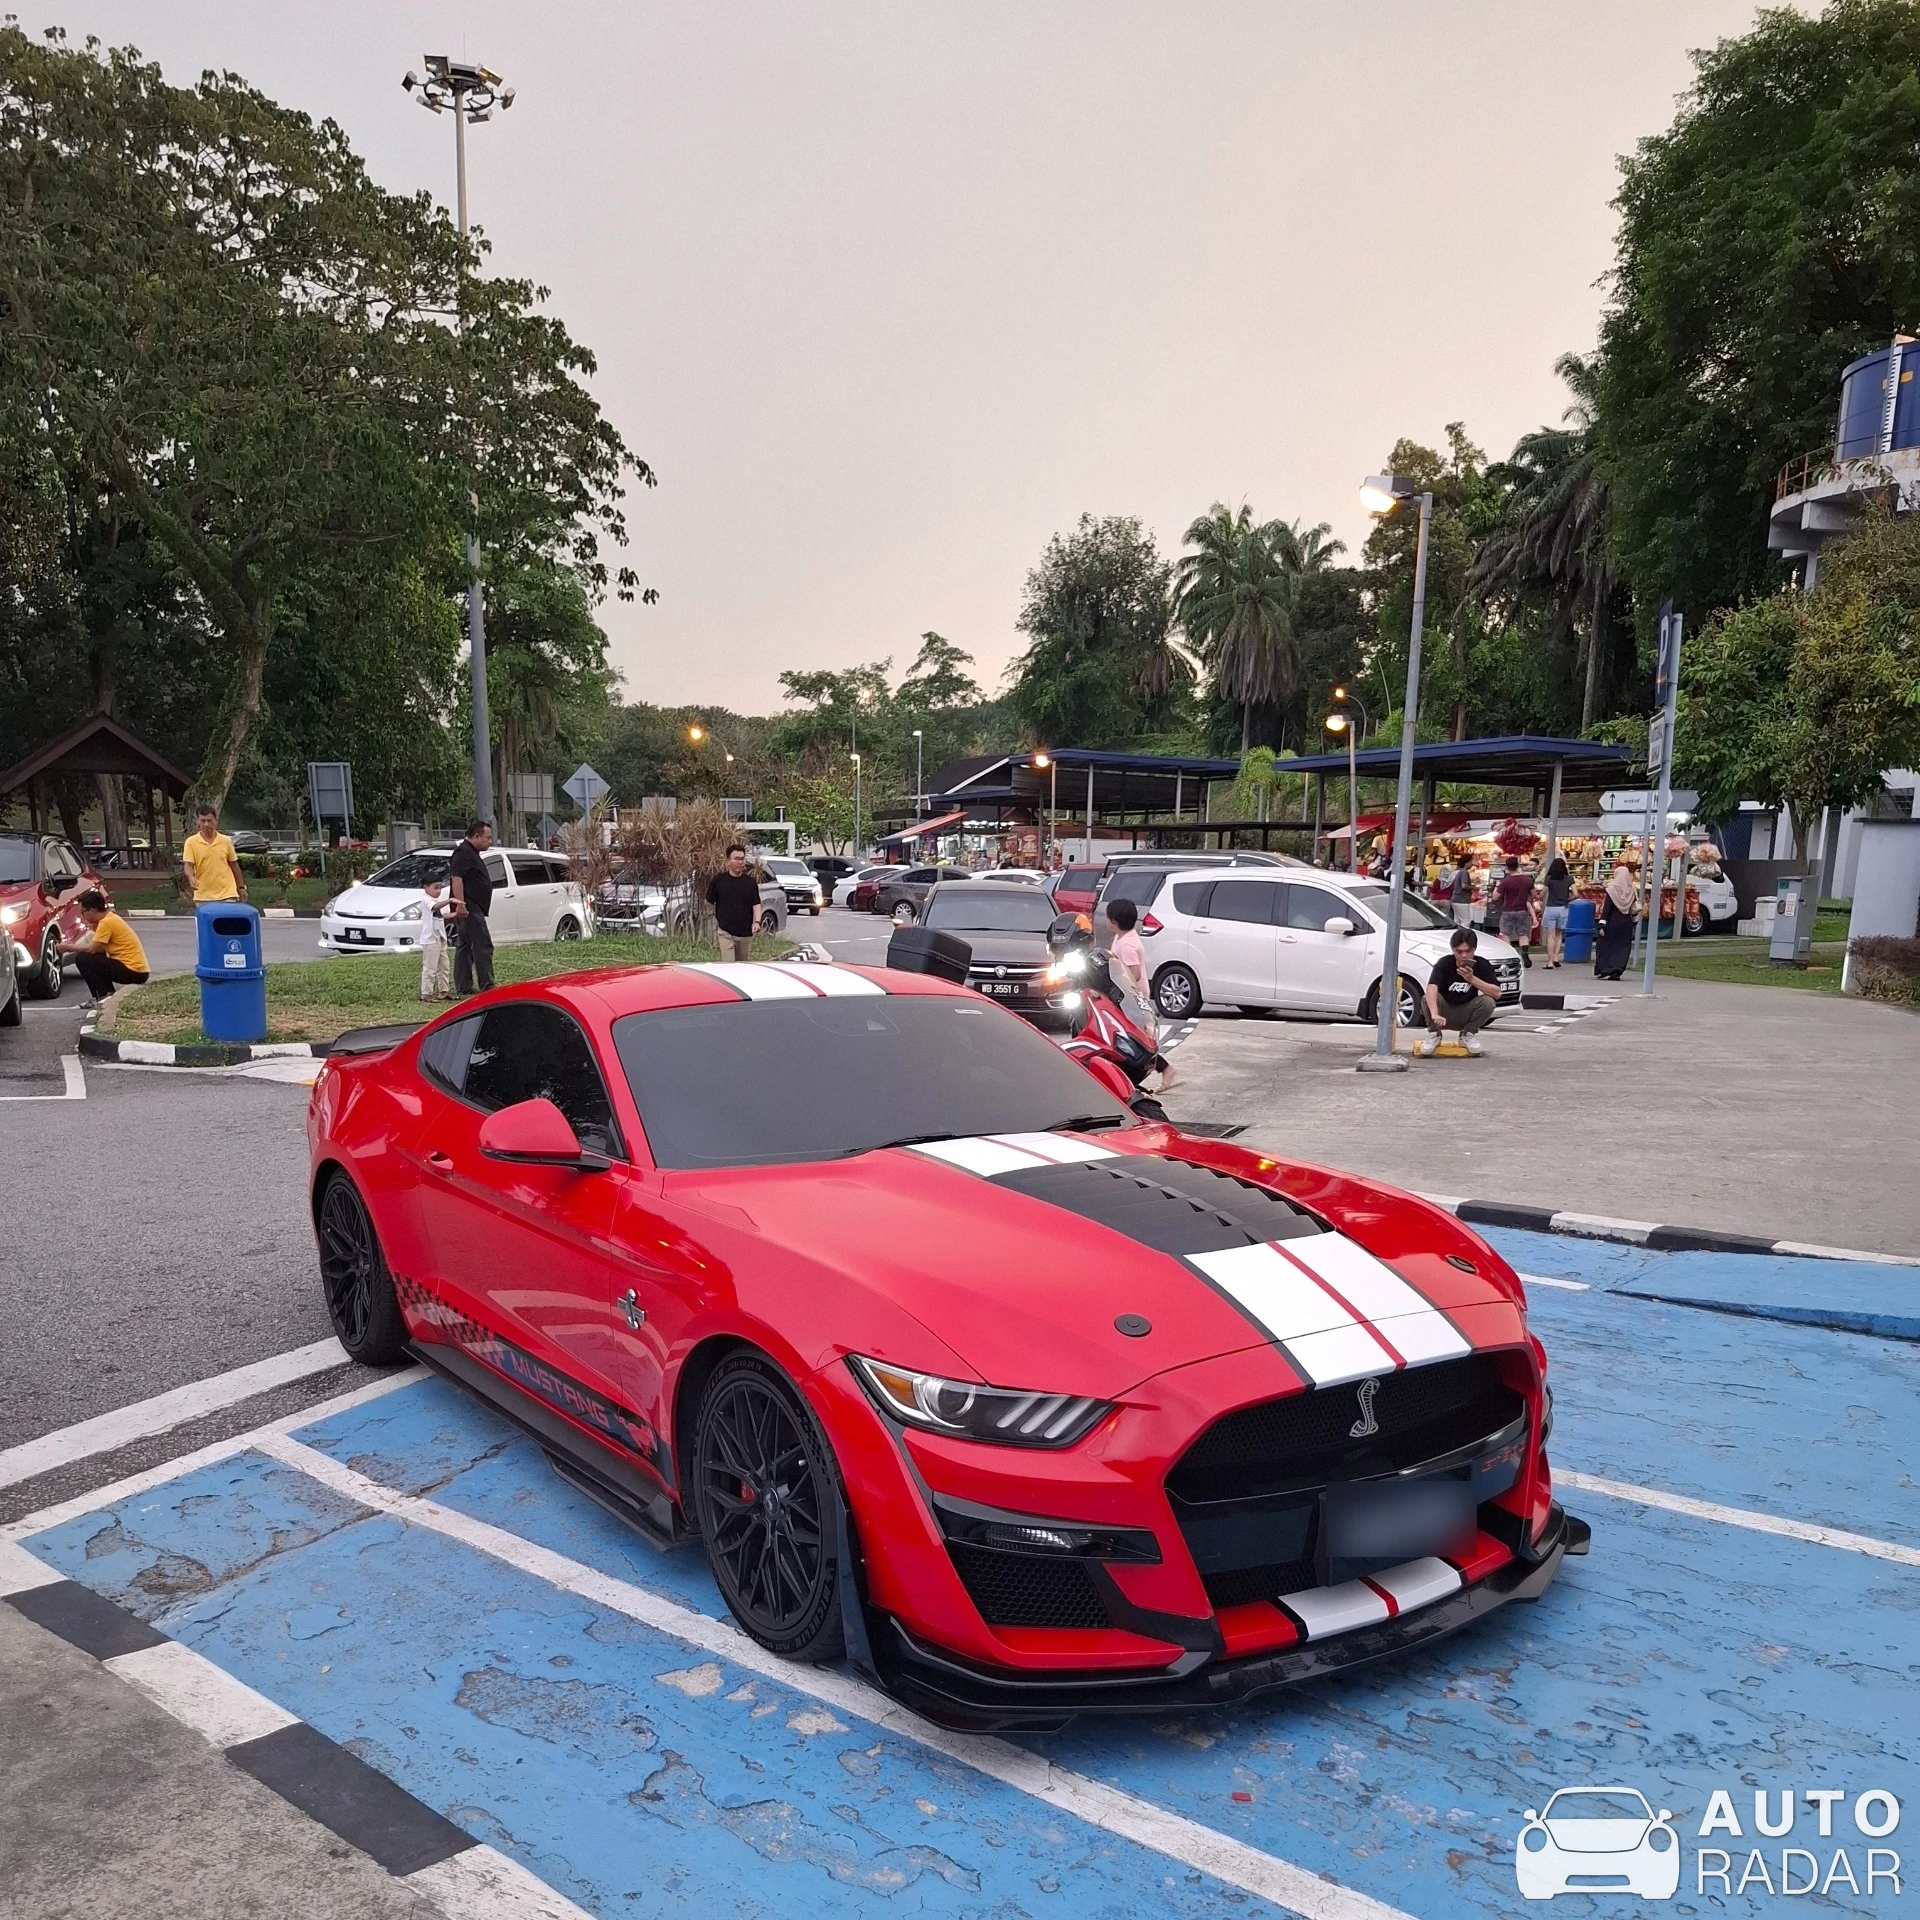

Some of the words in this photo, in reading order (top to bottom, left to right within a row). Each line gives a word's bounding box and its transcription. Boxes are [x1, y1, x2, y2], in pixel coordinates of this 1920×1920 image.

[981, 984, 992, 993] WB
[993, 984, 1012, 994] 3551
[1013, 985, 1020, 994] G
[510, 1350, 610, 1429] MUSTANG
